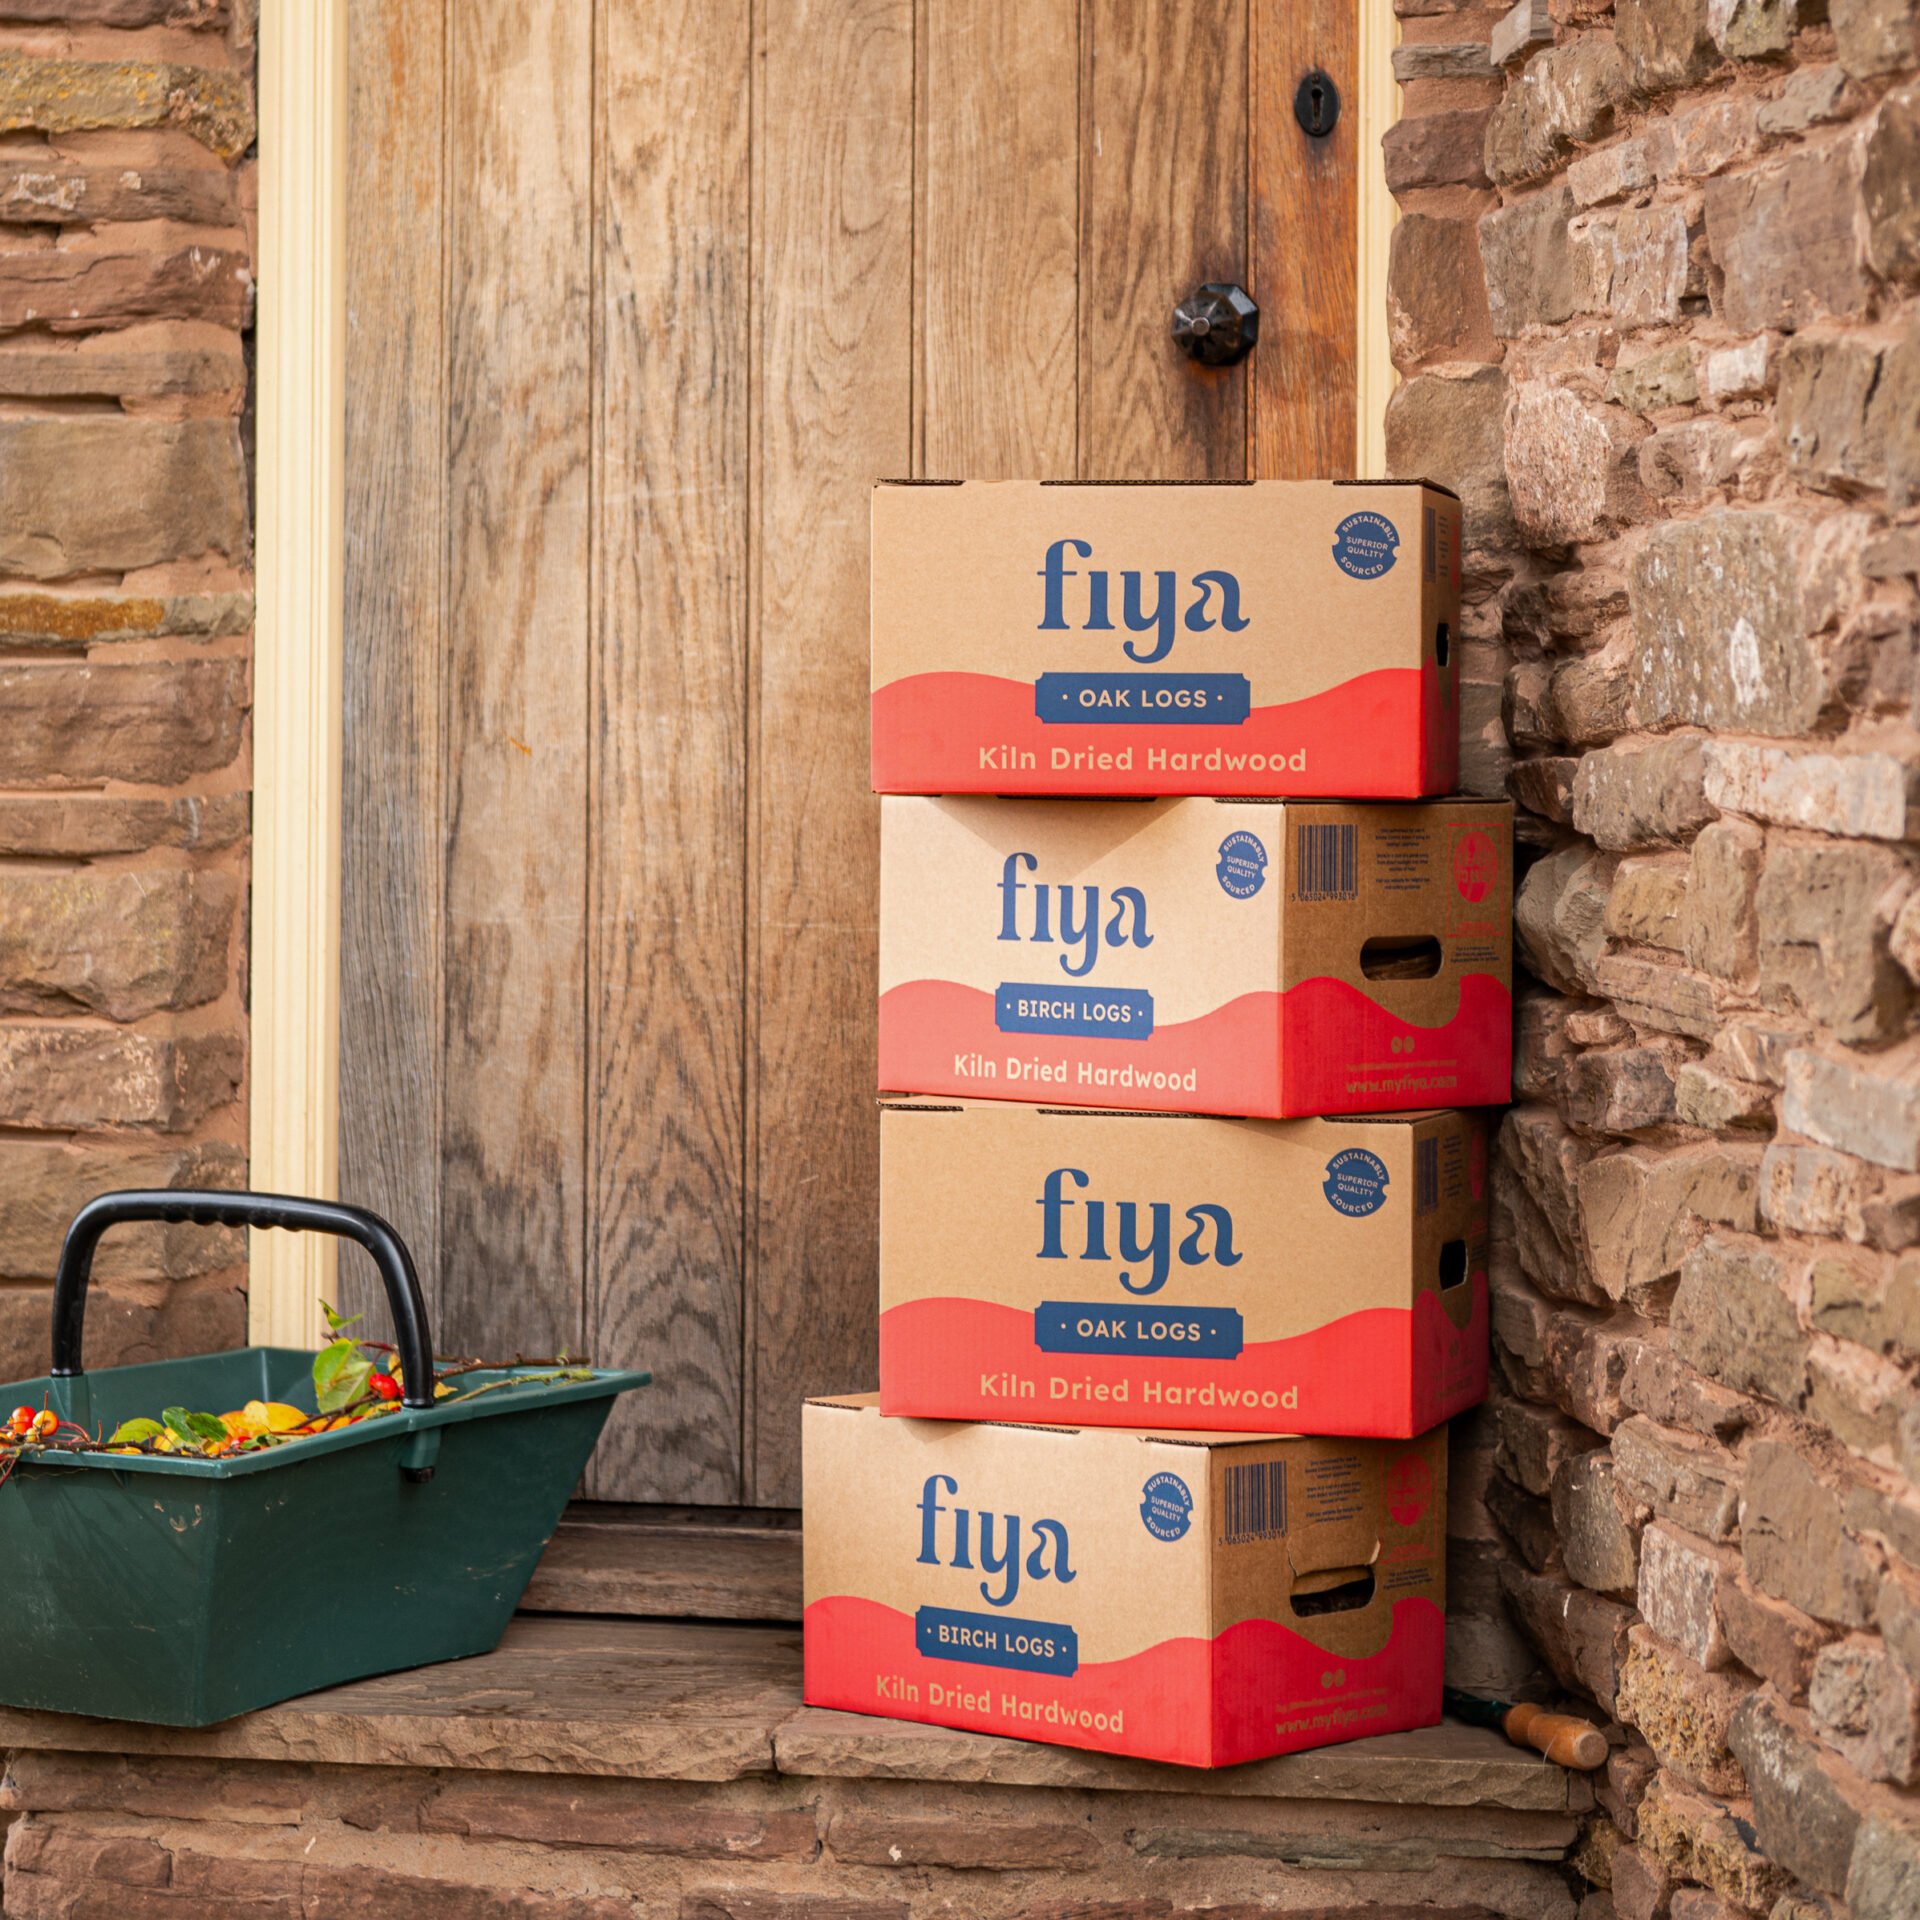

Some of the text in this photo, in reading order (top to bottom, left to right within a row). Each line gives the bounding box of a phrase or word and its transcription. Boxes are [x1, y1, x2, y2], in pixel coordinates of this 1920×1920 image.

[1341, 515, 1396, 543] SUSTAINABLY
[1346, 536, 1389, 550] SUPERIOR
[1347, 546, 1385, 559] QUALITY
[1340, 556, 1384, 576] SOURCED
[1037, 539, 1250, 664] fiya
[1079, 689, 1207, 708] OAK LOGS
[979, 744, 1306, 772] Kiln Dried Hardwood
[1223, 835, 1265, 863] SUSTAINABLY
[1226, 855, 1260, 870] SUPERIOR
[1227, 865, 1256, 879] QUALITY
[1222, 876, 1256, 895] SOURCED
[997, 852, 1154, 977] fiya
[1017, 998, 1132, 1023] BIRCH LOGS
[954, 1052, 1197, 1092] Kiln Dried Hardwood
[1332, 1152, 1385, 1180] SUSTAINABLY
[1337, 1173, 1379, 1188] SUPERIOR
[1337, 1183, 1375, 1197] QUALITY
[1331, 1193, 1374, 1213] SOURCED
[1035, 1167, 1243, 1296] fiya
[1076, 1318, 1201, 1342] OAK LOGS
[980, 1371, 1298, 1409] Kiln Dried Hardwood
[1147, 1476, 1190, 1506] SUSTAINABLY
[1151, 1496, 1185, 1514] SUPERIOR
[1151, 1506, 1181, 1522] QUALITY
[1146, 1516, 1181, 1537] SOURCED
[916, 1474, 1077, 1607] fiya
[939, 1624, 1055, 1658] BIRCH LOGS
[876, 1675, 1124, 1734] Kiln Dried Hardwood
